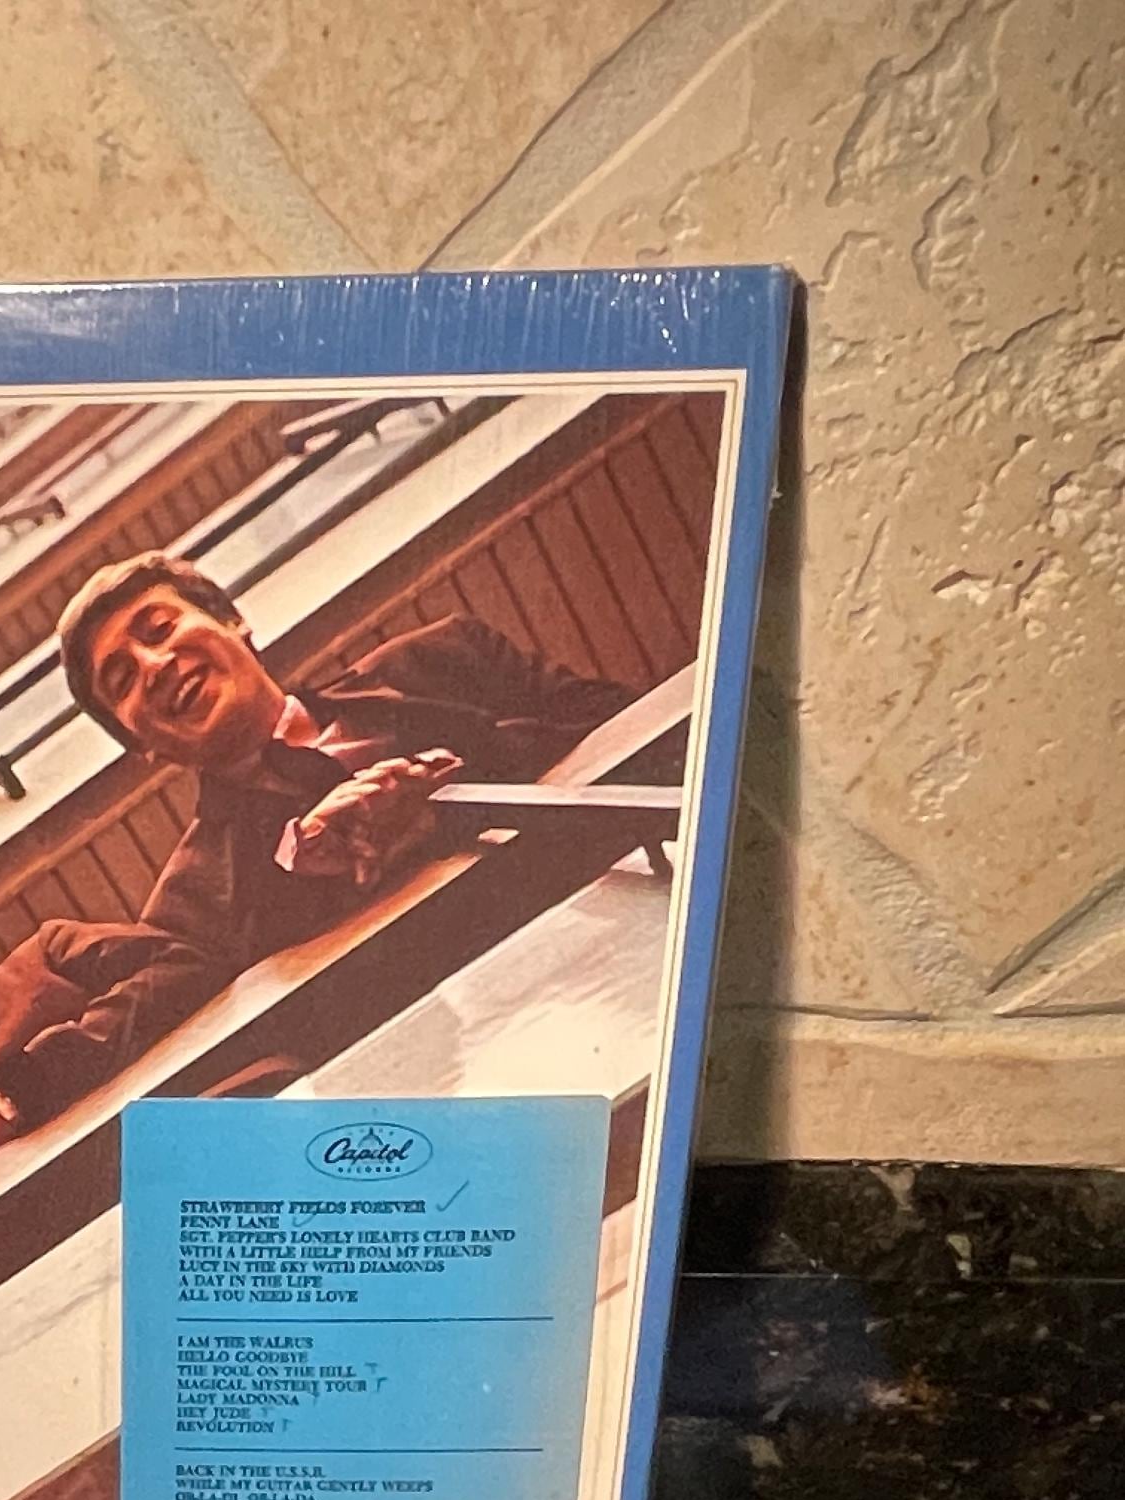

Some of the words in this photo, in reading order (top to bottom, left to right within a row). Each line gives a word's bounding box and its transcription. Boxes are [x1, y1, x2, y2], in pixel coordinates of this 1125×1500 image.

[324, 1137, 414, 1166] Capitol
[181, 1200, 283, 1214] STRAWBERRY
[289, 1200, 346, 1214] FIELDS
[351, 1200, 425, 1214] FOREVER
[179, 1215, 230, 1229] PENNY
[237, 1216, 279, 1229] LANE
[291, 1230, 353, 1244] LONELY
[357, 1230, 419, 1244] HEARTS
[423, 1230, 465, 1242] CLUB
[471, 1229, 515, 1242] BAND
[179, 1244, 222, 1258] WITH
[227, 1245, 235, 1258] A
[241, 1245, 296, 1259] LITTLE
[301, 1246, 342, 1259] HELP
[347, 1246, 391, 1258] FROM
[423, 1245, 492, 1258] FRIENDS
[179, 1259, 219, 1272] LUCY
[223, 1260, 239, 1273] IN
[245, 1260, 276, 1273] THE
[279, 1261, 306, 1273] SKY
[313, 1260, 355, 1274] WITH
[359, 1260, 444, 1273] DIAMONDS
[179, 1274, 188, 1287] A
[193, 1274, 223, 1287] DAY
[229, 1274, 245, 1287] IN
[251, 1274, 282, 1288] THE
[287, 1275, 322, 1288] LIFE
[177, 1288, 209, 1302] ALL
[215, 1289, 244, 1302] YOU
[249, 1290, 292, 1302] NEED
[297, 1290, 311, 1302] IS
[315, 1290, 358, 1303] LOVE
[177, 1335, 183, 1347] I
[187, 1336, 209, 1348] AM
[215, 1336, 245, 1348] THE
[251, 1336, 313, 1349] WALRUS
[177, 1349, 229, 1363] HELLO
[235, 1351, 308, 1364] GOODBYE
[177, 1364, 207, 1376] THE
[213, 1364, 253, 1377] FOOL
[257, 1364, 278, 1376] ON
[285, 1366, 315, 1377] THE
[319, 1365, 356, 1378] HILL
[177, 1378, 246, 1391] MAGICAL
[251, 1379, 319, 1392] MYSTERY
[325, 1379, 367, 1392] TOUR
[177, 1392, 215, 1405] LADY
[223, 1393, 298, 1405] MADONNA
[177, 1406, 206, 1418] HEY
[213, 1406, 251, 1420] JUDE
[176, 1420, 274, 1433] REVOLUTION
[175, 1464, 214, 1477] BACK
[219, 1464, 235, 1476] IN
[241, 1464, 271, 1477] THE
[175, 1478, 225, 1490] WHILE
[255, 1479, 312, 1491] GUITAR
[317, 1480, 376, 1492] GENTLY
[381, 1480, 433, 1492] WEEPS
